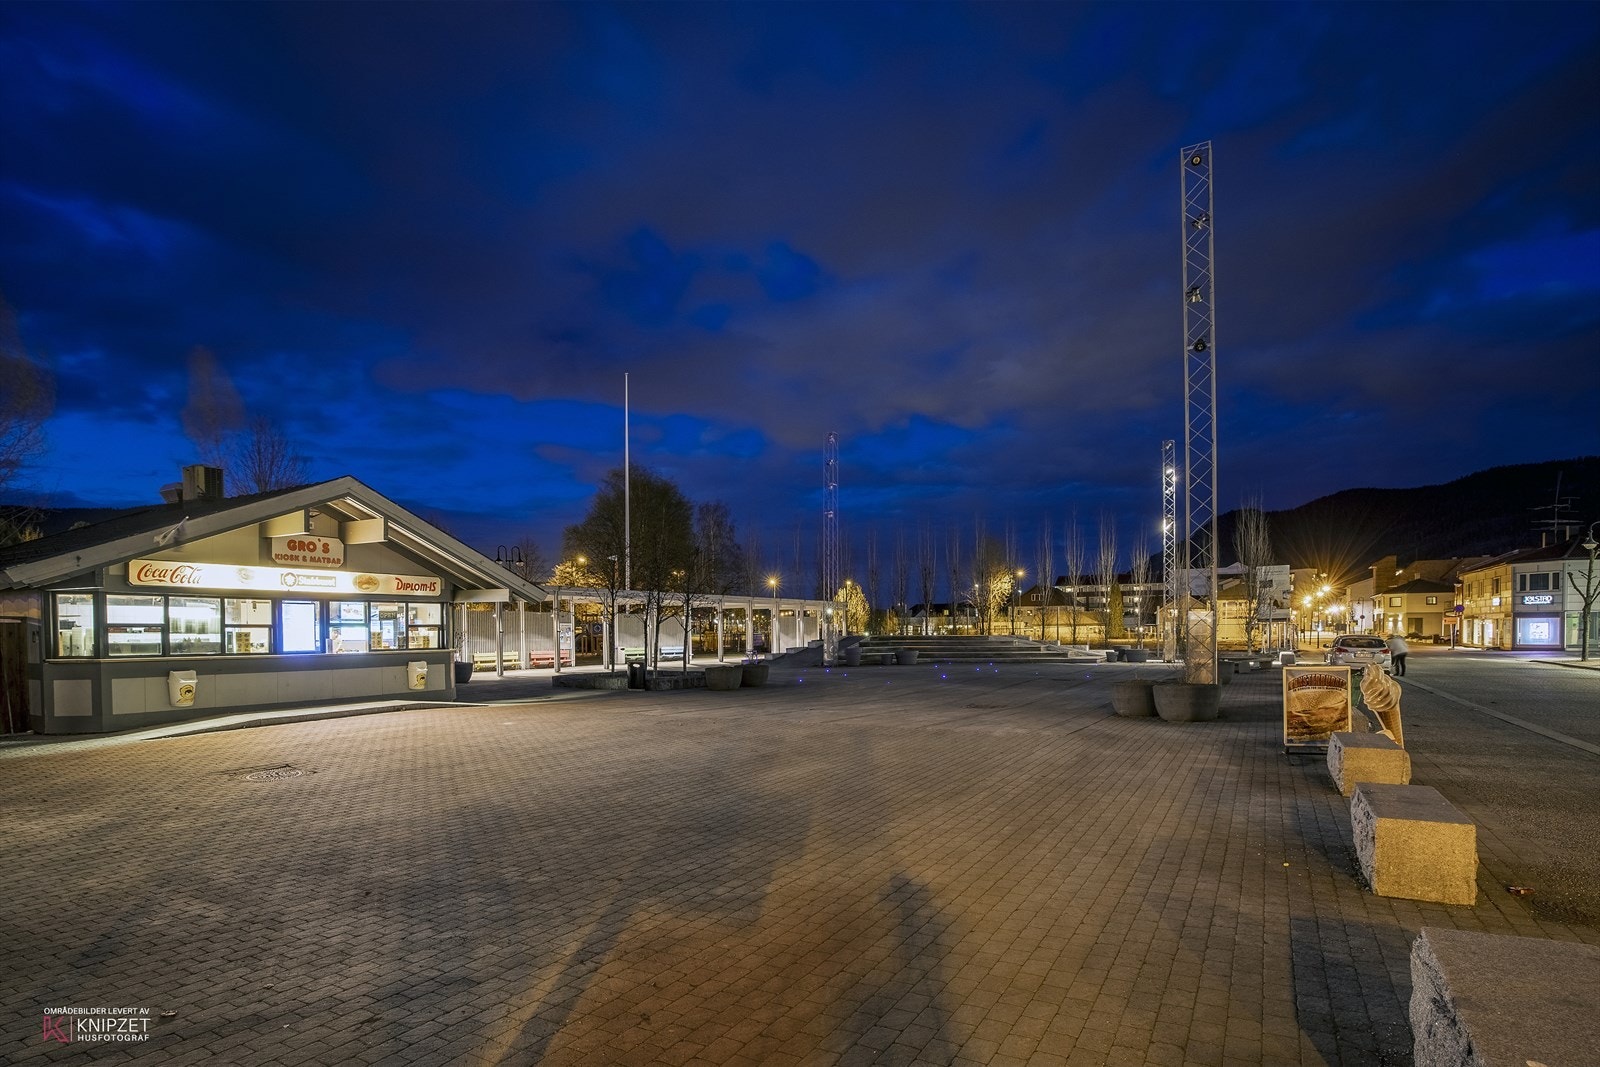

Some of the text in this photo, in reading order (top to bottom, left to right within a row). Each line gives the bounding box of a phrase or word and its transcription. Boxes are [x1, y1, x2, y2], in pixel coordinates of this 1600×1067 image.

[275, 553, 300, 562] KIOSK
[309, 556, 342, 564] MATBAR
[137, 563, 202, 584] Coca-Cola
